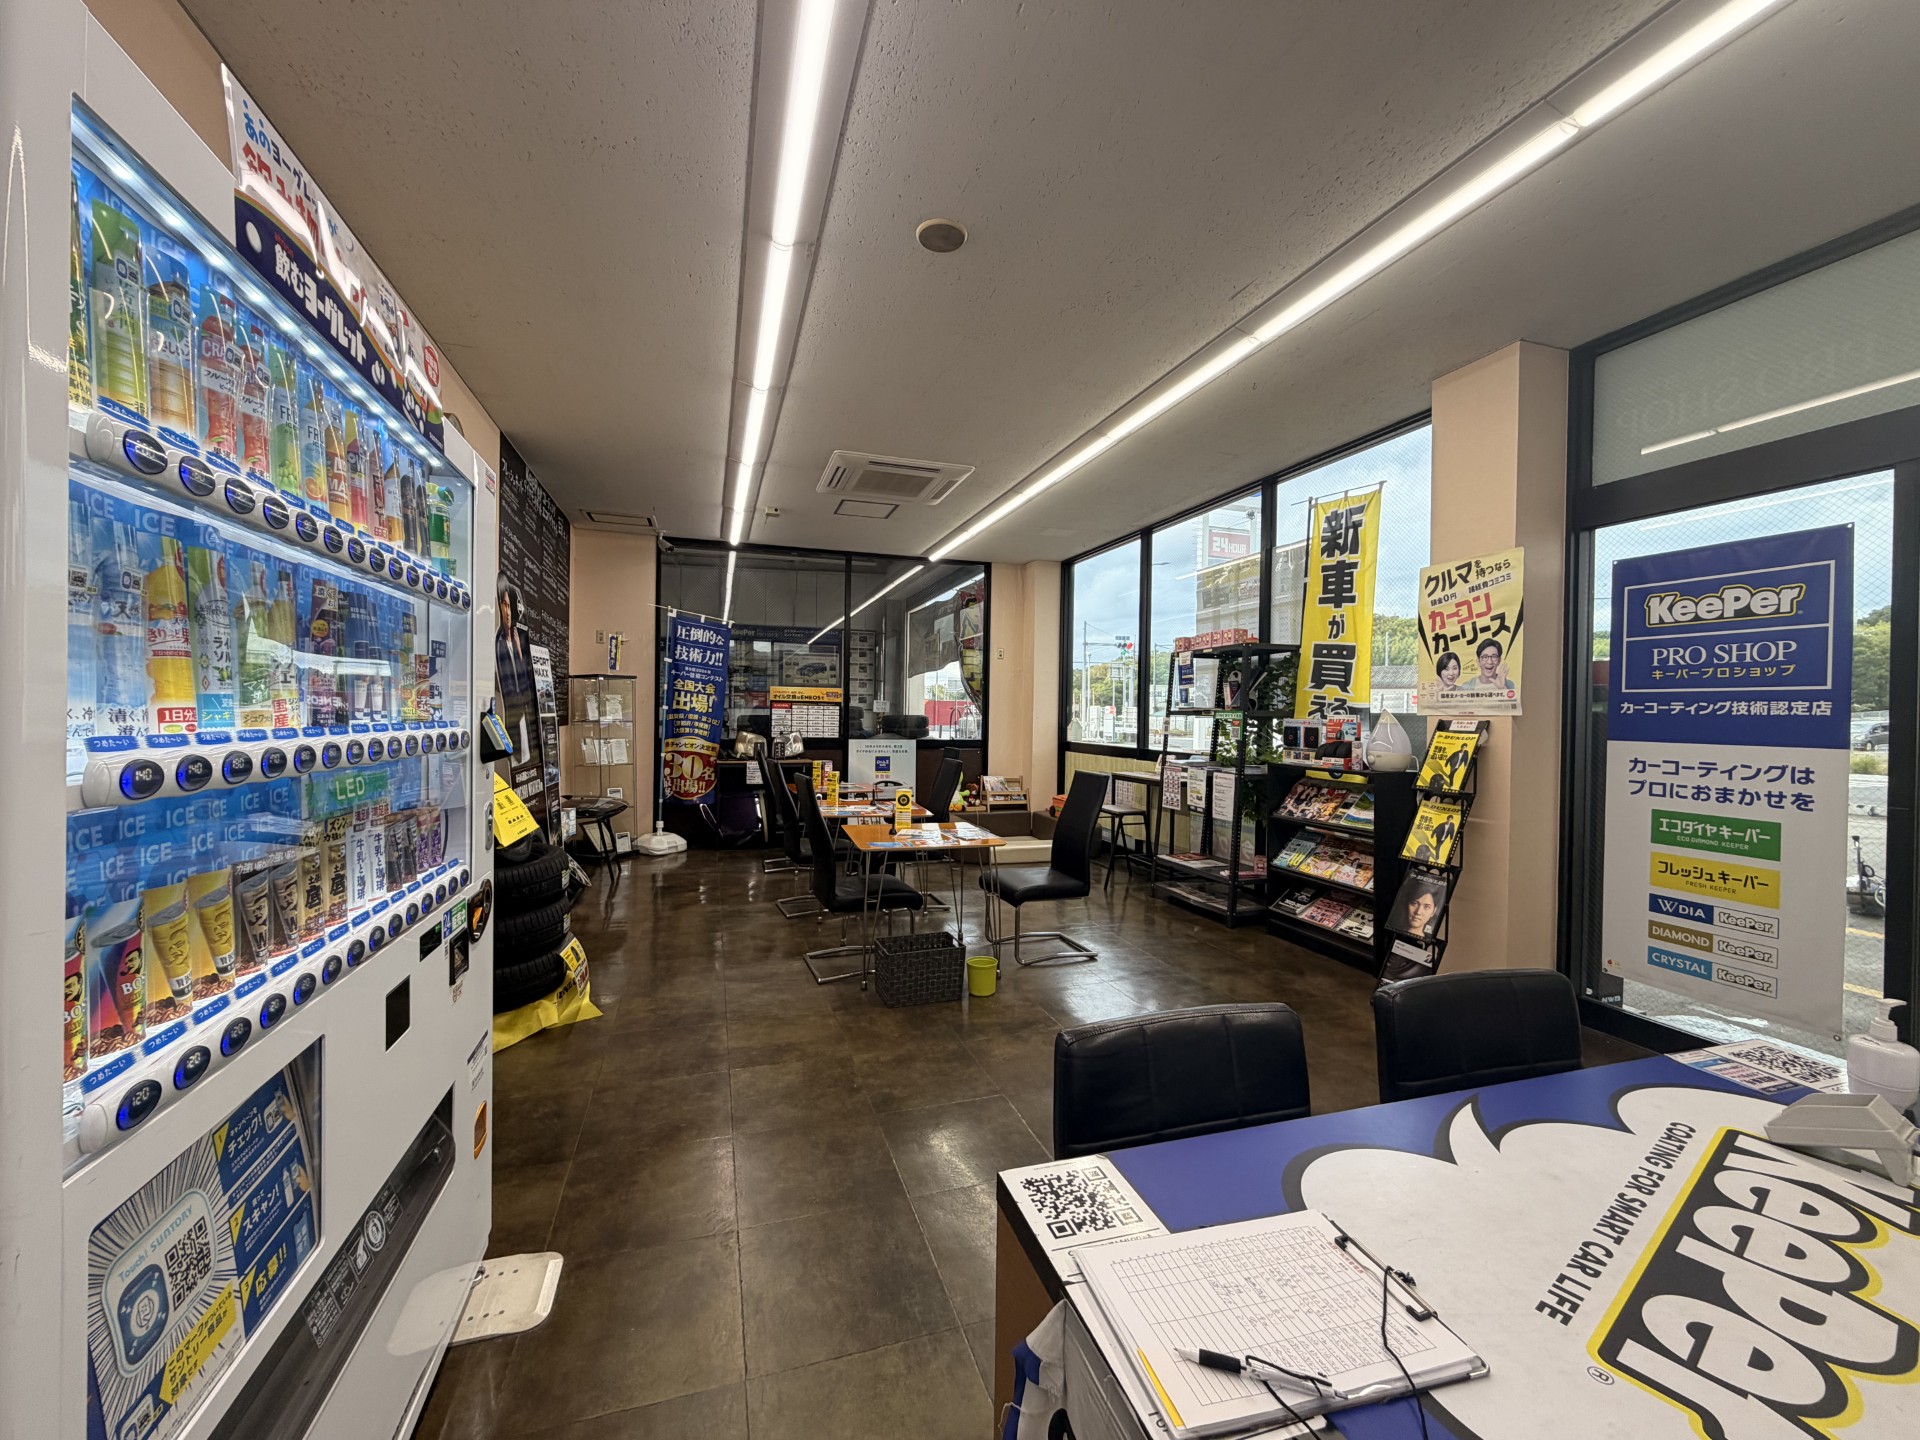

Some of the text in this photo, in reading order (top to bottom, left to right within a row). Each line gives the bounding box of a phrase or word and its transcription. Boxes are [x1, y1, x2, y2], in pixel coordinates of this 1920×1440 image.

[151, 229, 187, 262] ICE
[84, 489, 115, 520] ICE
[135, 508, 176, 537] ICE
[1212, 536, 1247, 555] 24 HOUR
[1475, 558, 1511, 580] 持つなら
[1428, 591, 1492, 633] カーコン
[1646, 584, 1803, 626] KeePer
[676, 625, 725, 646] 圧倒的な
[1432, 611, 1511, 655] カーリース
[532, 655, 550, 667] SPORT
[675, 644, 723, 666] 技術力!!
[1651, 640, 1798, 667] PRO SHOP
[1651, 664, 1797, 680] キーパープロショップ
[673, 678, 716, 695] 全国大会
[272, 698, 289, 729] 国産
[672, 691, 714, 713] 出場!
[1620, 700, 1833, 717] カーコーティング技術認定店
[93, 737, 130, 748] つめた〜い
[151, 735, 183, 745] つめた〜い
[1443, 733, 1476, 741] DUNLOP
[135, 769, 152, 781] 140
[188, 762, 202, 774] 140
[1628, 757, 1815, 785] カーコーティングは
[269, 787, 289, 804] ICE
[335, 776, 365, 800] LED
[1628, 779, 1815, 812] プロにおまかせを
[208, 799, 228, 820] ICE
[240, 792, 260, 811] ICE
[118, 815, 146, 839] ICE
[166, 805, 196, 828] ICE
[224, 823, 245, 843] ICE
[1659, 818, 1771, 843] エコダイヤキーパー
[140, 841, 173, 867] ICE
[191, 832, 214, 854] ICE
[1676, 835, 1749, 850] ECO DIAMOND KEEPER
[100, 854, 125, 881] ICE
[356, 838, 366, 901] 牛乳と珈琲
[374, 832, 386, 891] 牛乳と珈琲
[1658, 860, 1769, 890] フレッシュキーパー
[1685, 880, 1736, 894] FRESH KEEPER
[1718, 911, 1773, 933] KeePer
[1652, 925, 1772, 963] DIAMOND KeePer
[1651, 952, 1771, 992] CRYSTAL KeePer
[238, 977, 262, 994] つめた〜い
[197, 1000, 224, 1018] つめた〜い
[149, 1027, 180, 1049] つめた〜い
[186, 1052, 201, 1068] 120
[89, 1060, 126, 1085] つめた〜い
[132, 1087, 150, 1106] 120
[227, 1112, 264, 1159] チェック!
[242, 1184, 281, 1237] スキャン!
[1534, 1121, 1698, 1327] COATING FOR SMART CAR LIFE
[118, 1205, 194, 1282] Touch! SUNTORY
[255, 1242, 287, 1298] 応募!!
[167, 1291, 233, 1373] このマークがついている
